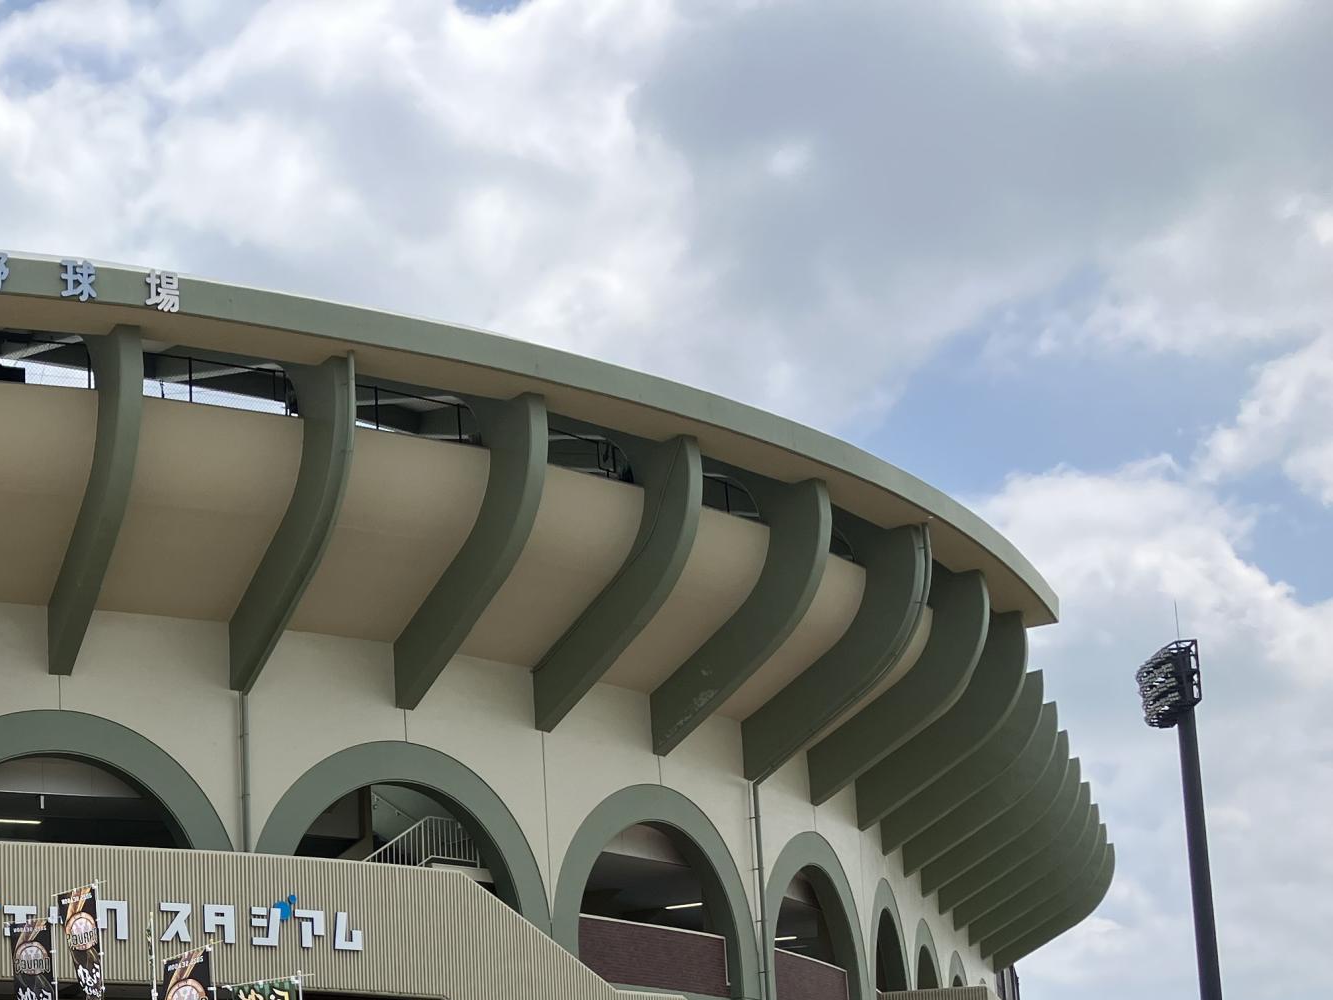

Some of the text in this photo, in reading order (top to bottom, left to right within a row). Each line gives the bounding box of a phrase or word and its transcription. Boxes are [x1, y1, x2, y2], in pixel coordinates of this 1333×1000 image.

[160, 894, 364, 951] スタジアム
